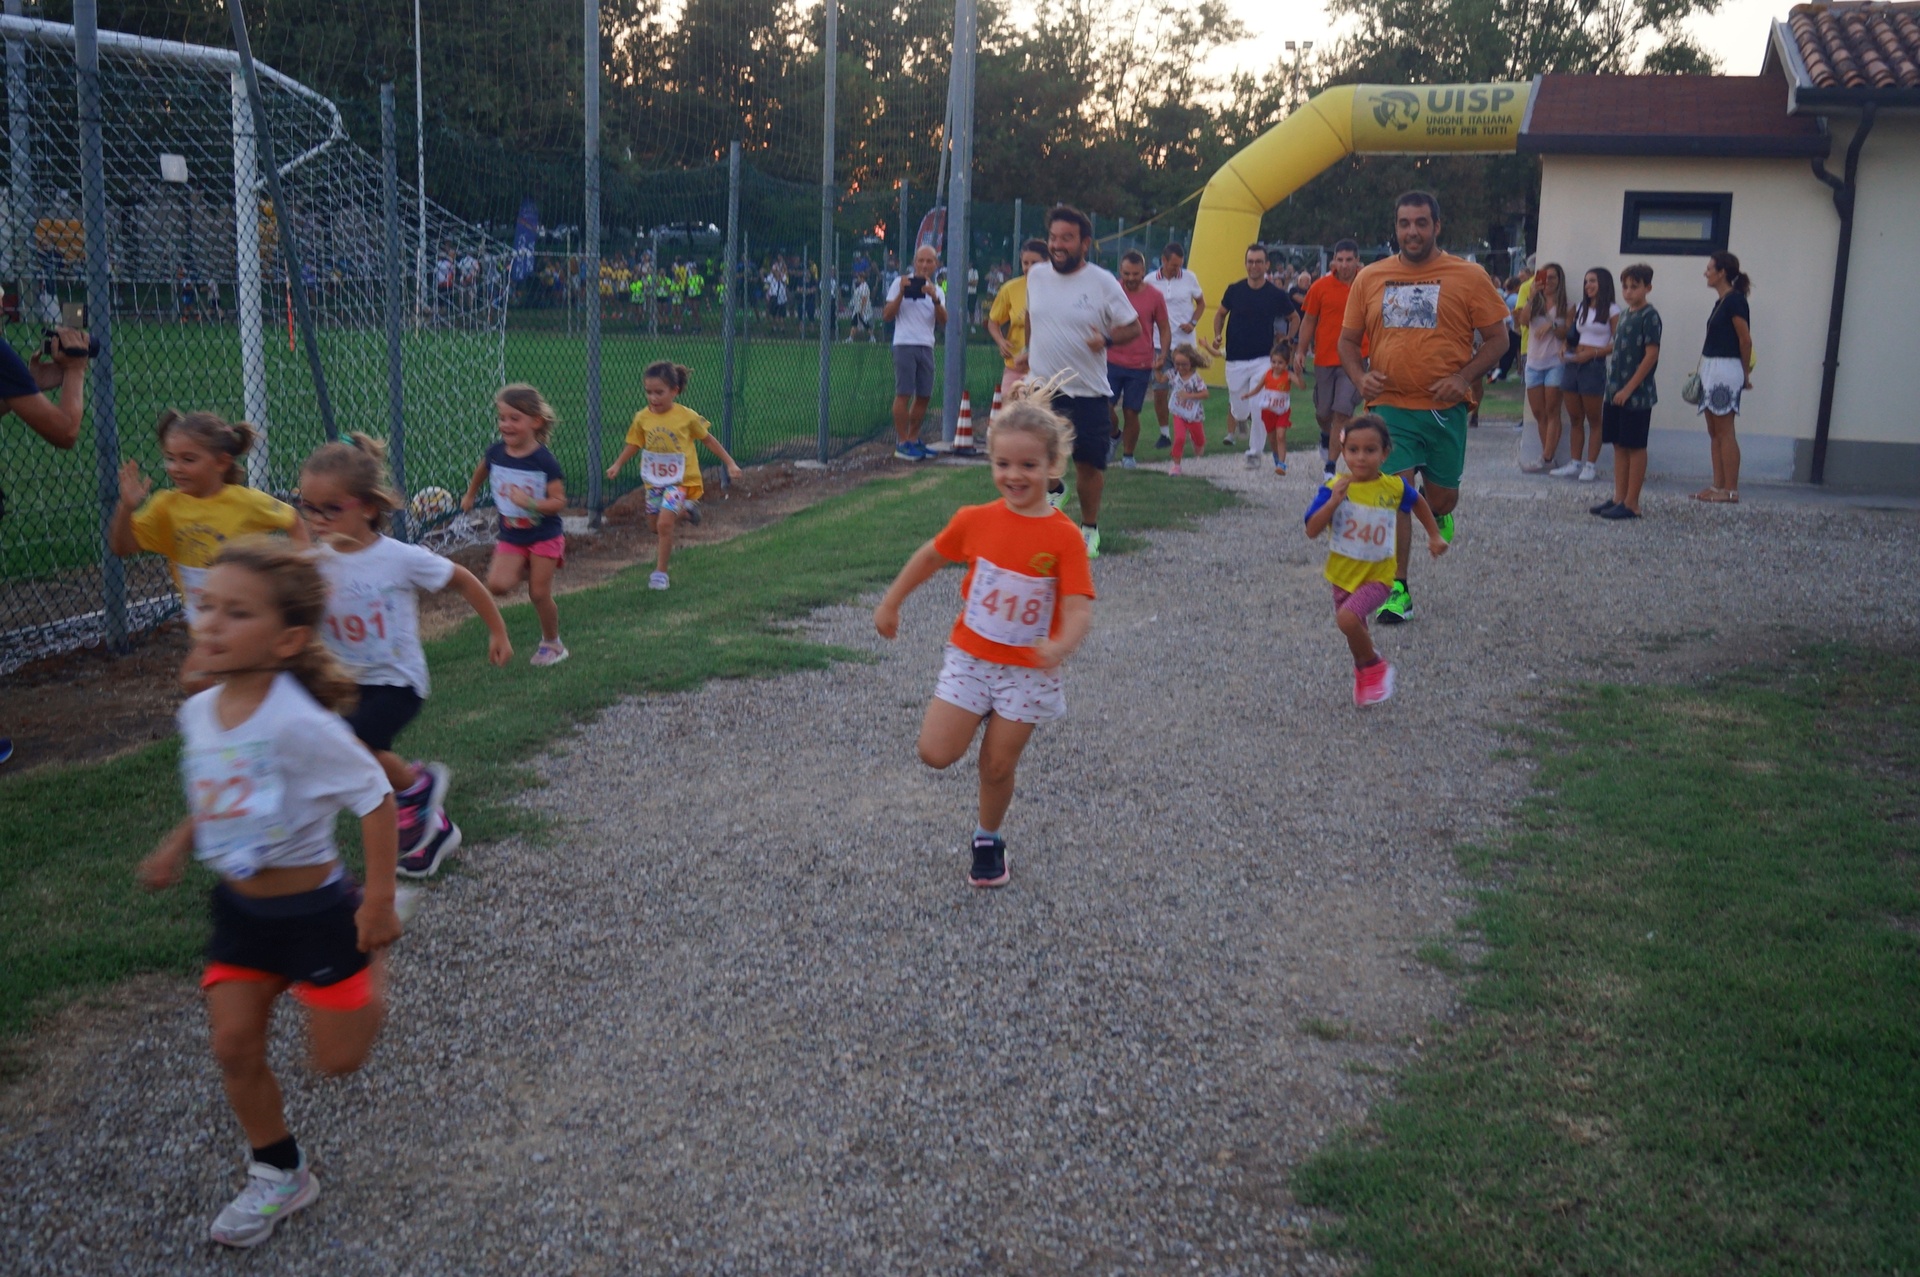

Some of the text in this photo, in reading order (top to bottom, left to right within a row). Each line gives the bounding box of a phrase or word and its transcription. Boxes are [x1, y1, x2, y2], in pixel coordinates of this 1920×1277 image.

[1427, 88, 1514, 113] UISP
[1426, 115, 1513, 125] UNIONE ITALIANA
[1426, 126, 1507, 136] SPORT PER TUTTI
[650, 462, 678, 478] 159
[1342, 518, 1387, 547] 240
[981, 589, 1043, 626] 418
[327, 611, 386, 643] 191
